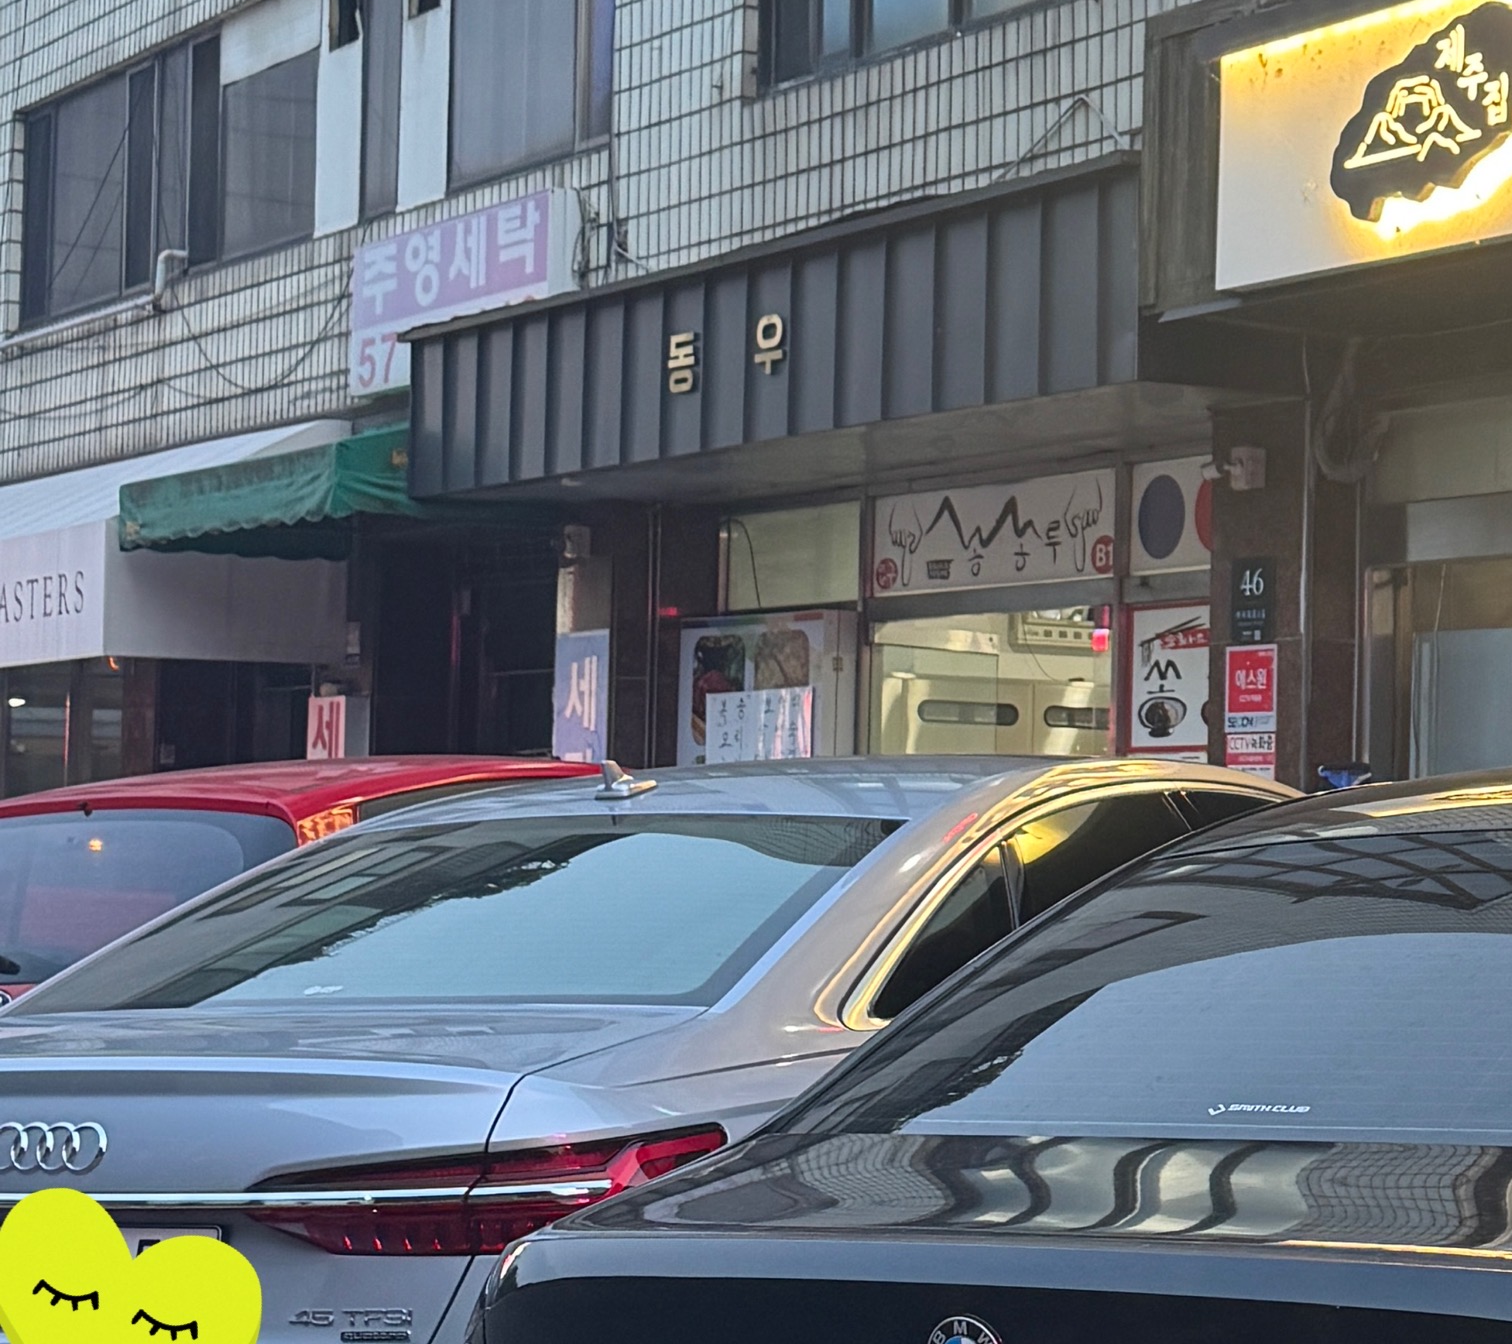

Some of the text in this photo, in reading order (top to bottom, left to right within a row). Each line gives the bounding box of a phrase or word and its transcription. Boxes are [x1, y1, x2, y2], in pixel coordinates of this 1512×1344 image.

[1434, 23, 1510, 126] 제주집
[360, 200, 542, 315] 주영세탁
[1240, 568, 1264, 596] 46
[1235, 667, 1268, 691] 에스원
